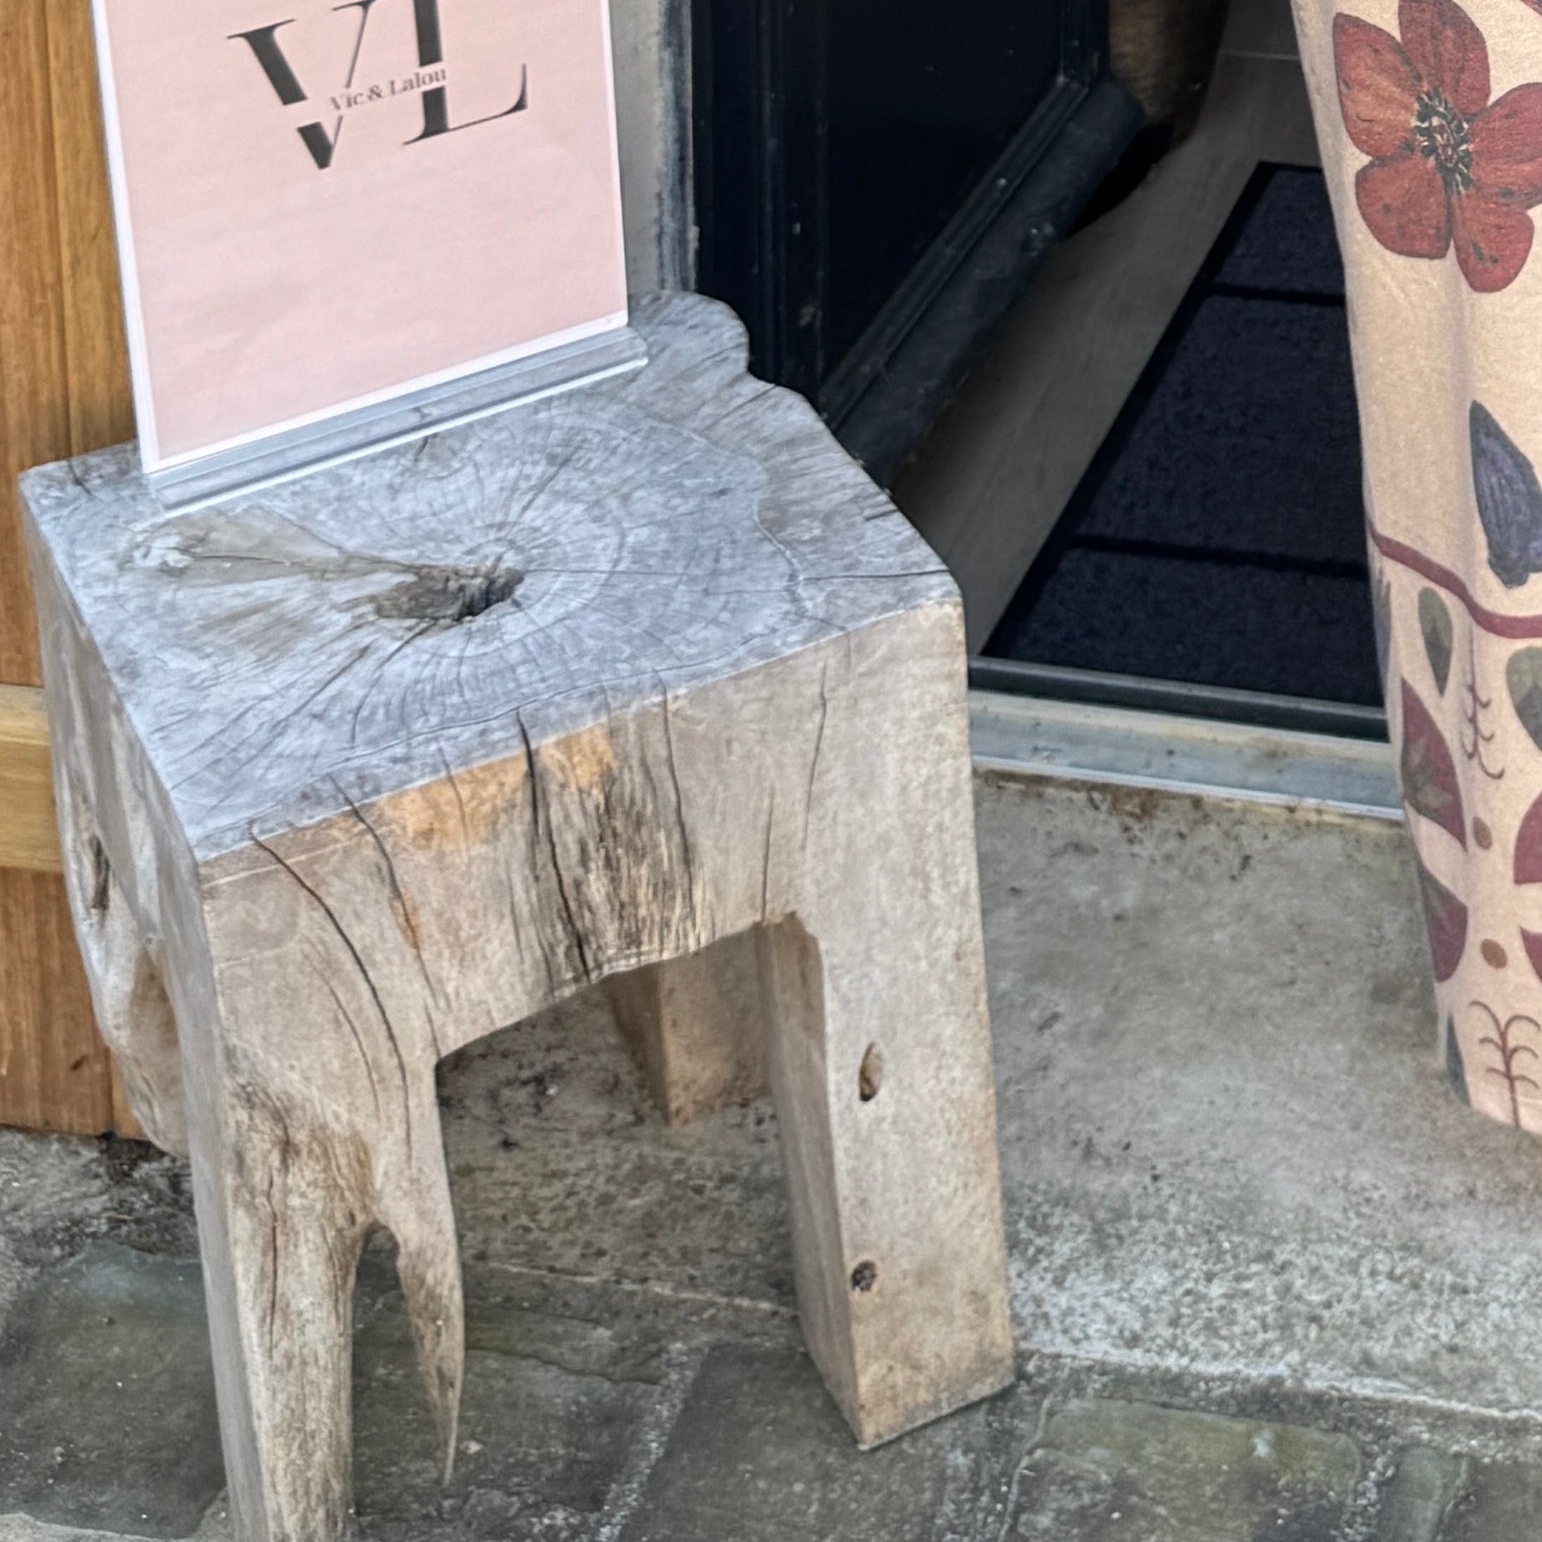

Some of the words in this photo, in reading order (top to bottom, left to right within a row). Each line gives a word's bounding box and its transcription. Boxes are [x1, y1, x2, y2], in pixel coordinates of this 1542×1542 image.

[330, 91, 364, 111] Vic
[367, 84, 385, 101] &
[388, 68, 447, 96] Lalou
